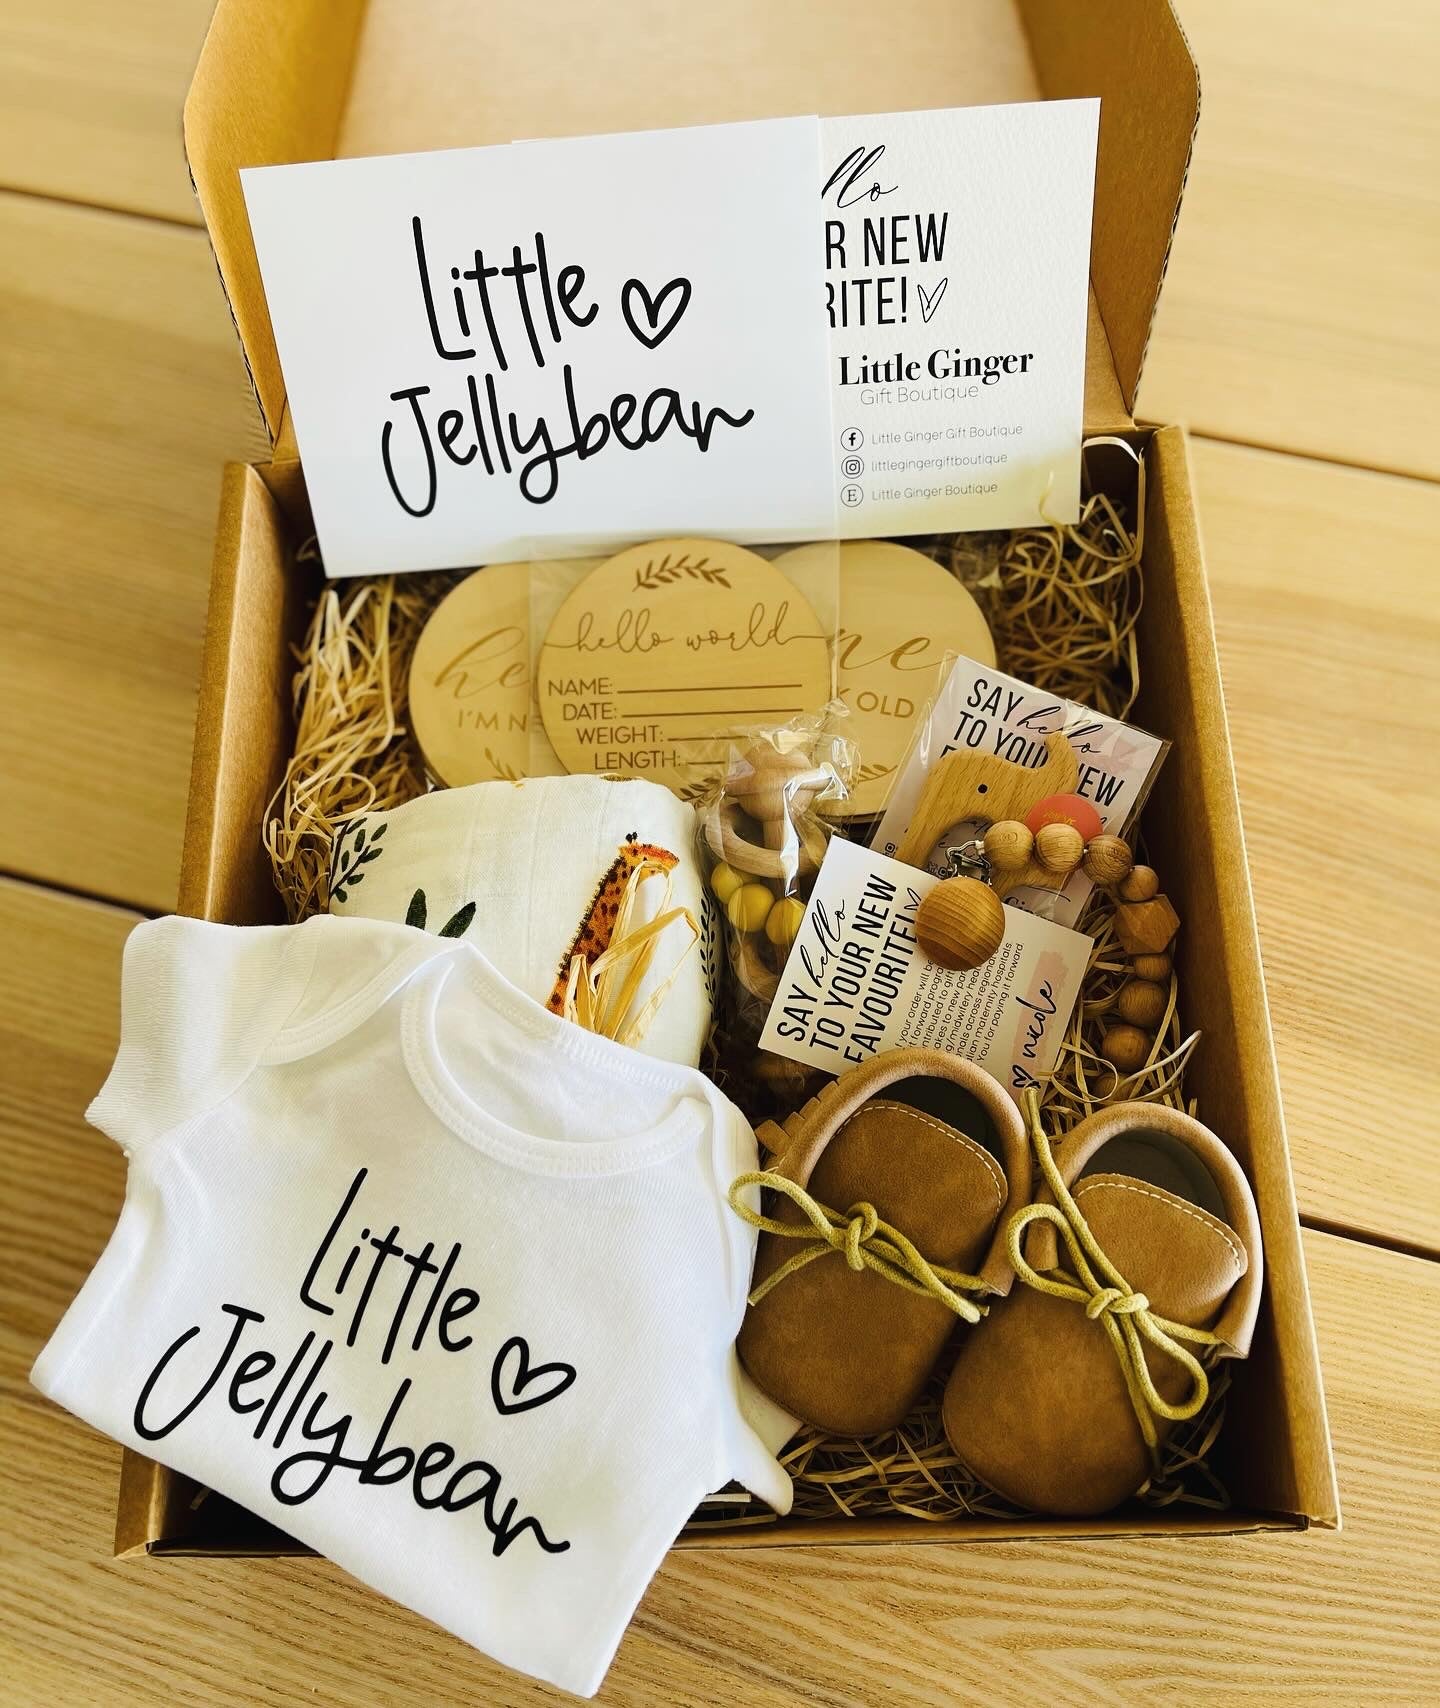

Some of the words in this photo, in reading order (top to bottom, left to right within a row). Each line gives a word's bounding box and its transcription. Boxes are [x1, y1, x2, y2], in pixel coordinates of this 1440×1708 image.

[863, 212, 948, 267] NEW
[411, 216, 599, 371] Little
[838, 352, 921, 386] Little
[927, 348, 1034, 386] Ginger
[860, 387, 893, 405] Gift
[897, 385, 979, 405] Boutique
[381, 363, 755, 518] Jellybean
[872, 432, 901, 445] Little
[904, 430, 943, 444] Ginger
[945, 427, 967, 440] Gift
[969, 424, 1023, 440] Boutique
[872, 453, 1008, 474] littlegingergiftboutique
[872, 488, 900, 501] Little
[903, 486, 943, 500] Ginger
[945, 482, 998, 497] Boutique
[543, 607, 673, 654] hello
[685, 600, 825, 651] world
[547, 677, 614, 697] NAME:
[562, 703, 618, 721] DATE:
[856, 691, 915, 718] OLD
[966, 678, 1025, 722] SAY
[458, 709, 499, 731] I'M
[576, 725, 664, 745] WEIGHT:
[594, 750, 682, 770] LENGTH:
[952, 711, 988, 748] TO
[993, 727, 1049, 769] YOU
[1077, 763, 1125, 807] EW
[851, 873, 898, 938] NEW
[777, 984, 818, 1042] SAY
[800, 898, 845, 988] hello
[824, 941, 875, 1009] YOUR
[975, 989, 998, 1039] maternity
[991, 942, 1013, 990] hospitals
[899, 1019, 911, 1043] your
[908, 992, 922, 1018] order
[919, 972, 930, 990] will
[910, 1000, 932, 1040] forward
[927, 967, 944, 1001] progra
[922, 1001, 944, 1049] ntributed
[938, 989, 948, 1000] to
[934, 1026, 948, 1049] akes
[942, 1014, 951, 1024] to
[948, 989, 961, 1013] new
[956, 971, 966, 990] par
[965, 998, 982, 1031] across
[977, 1043, 990, 1061] You
[984, 1027, 995, 1041] for
[991, 991, 1010, 1027] paying
[1003, 982, 1011, 991] it
[1015, 980, 1057, 1059] nicole
[809, 1017, 846, 1051] TO
[300, 1167, 481, 1365] Little
[133, 1303, 571, 1557] Jellybean
